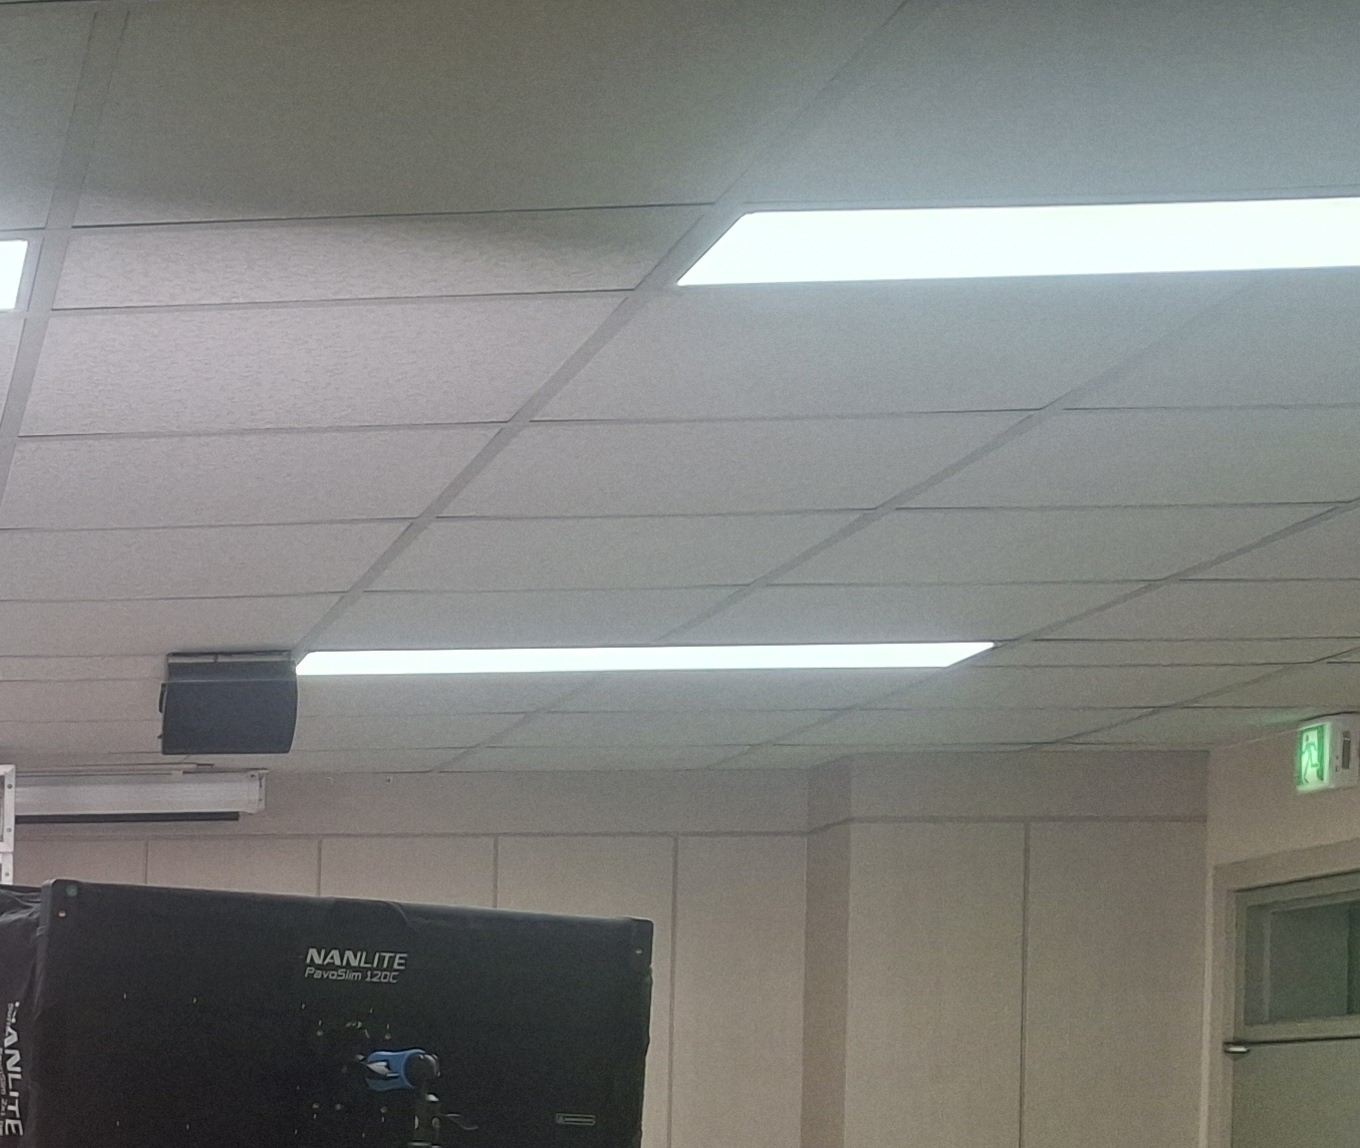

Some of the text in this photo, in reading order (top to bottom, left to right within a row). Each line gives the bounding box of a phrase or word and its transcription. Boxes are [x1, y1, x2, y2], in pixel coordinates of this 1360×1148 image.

[306, 948, 408, 970] NANLITE
[305, 966, 399, 983] PavoSlim 120C
